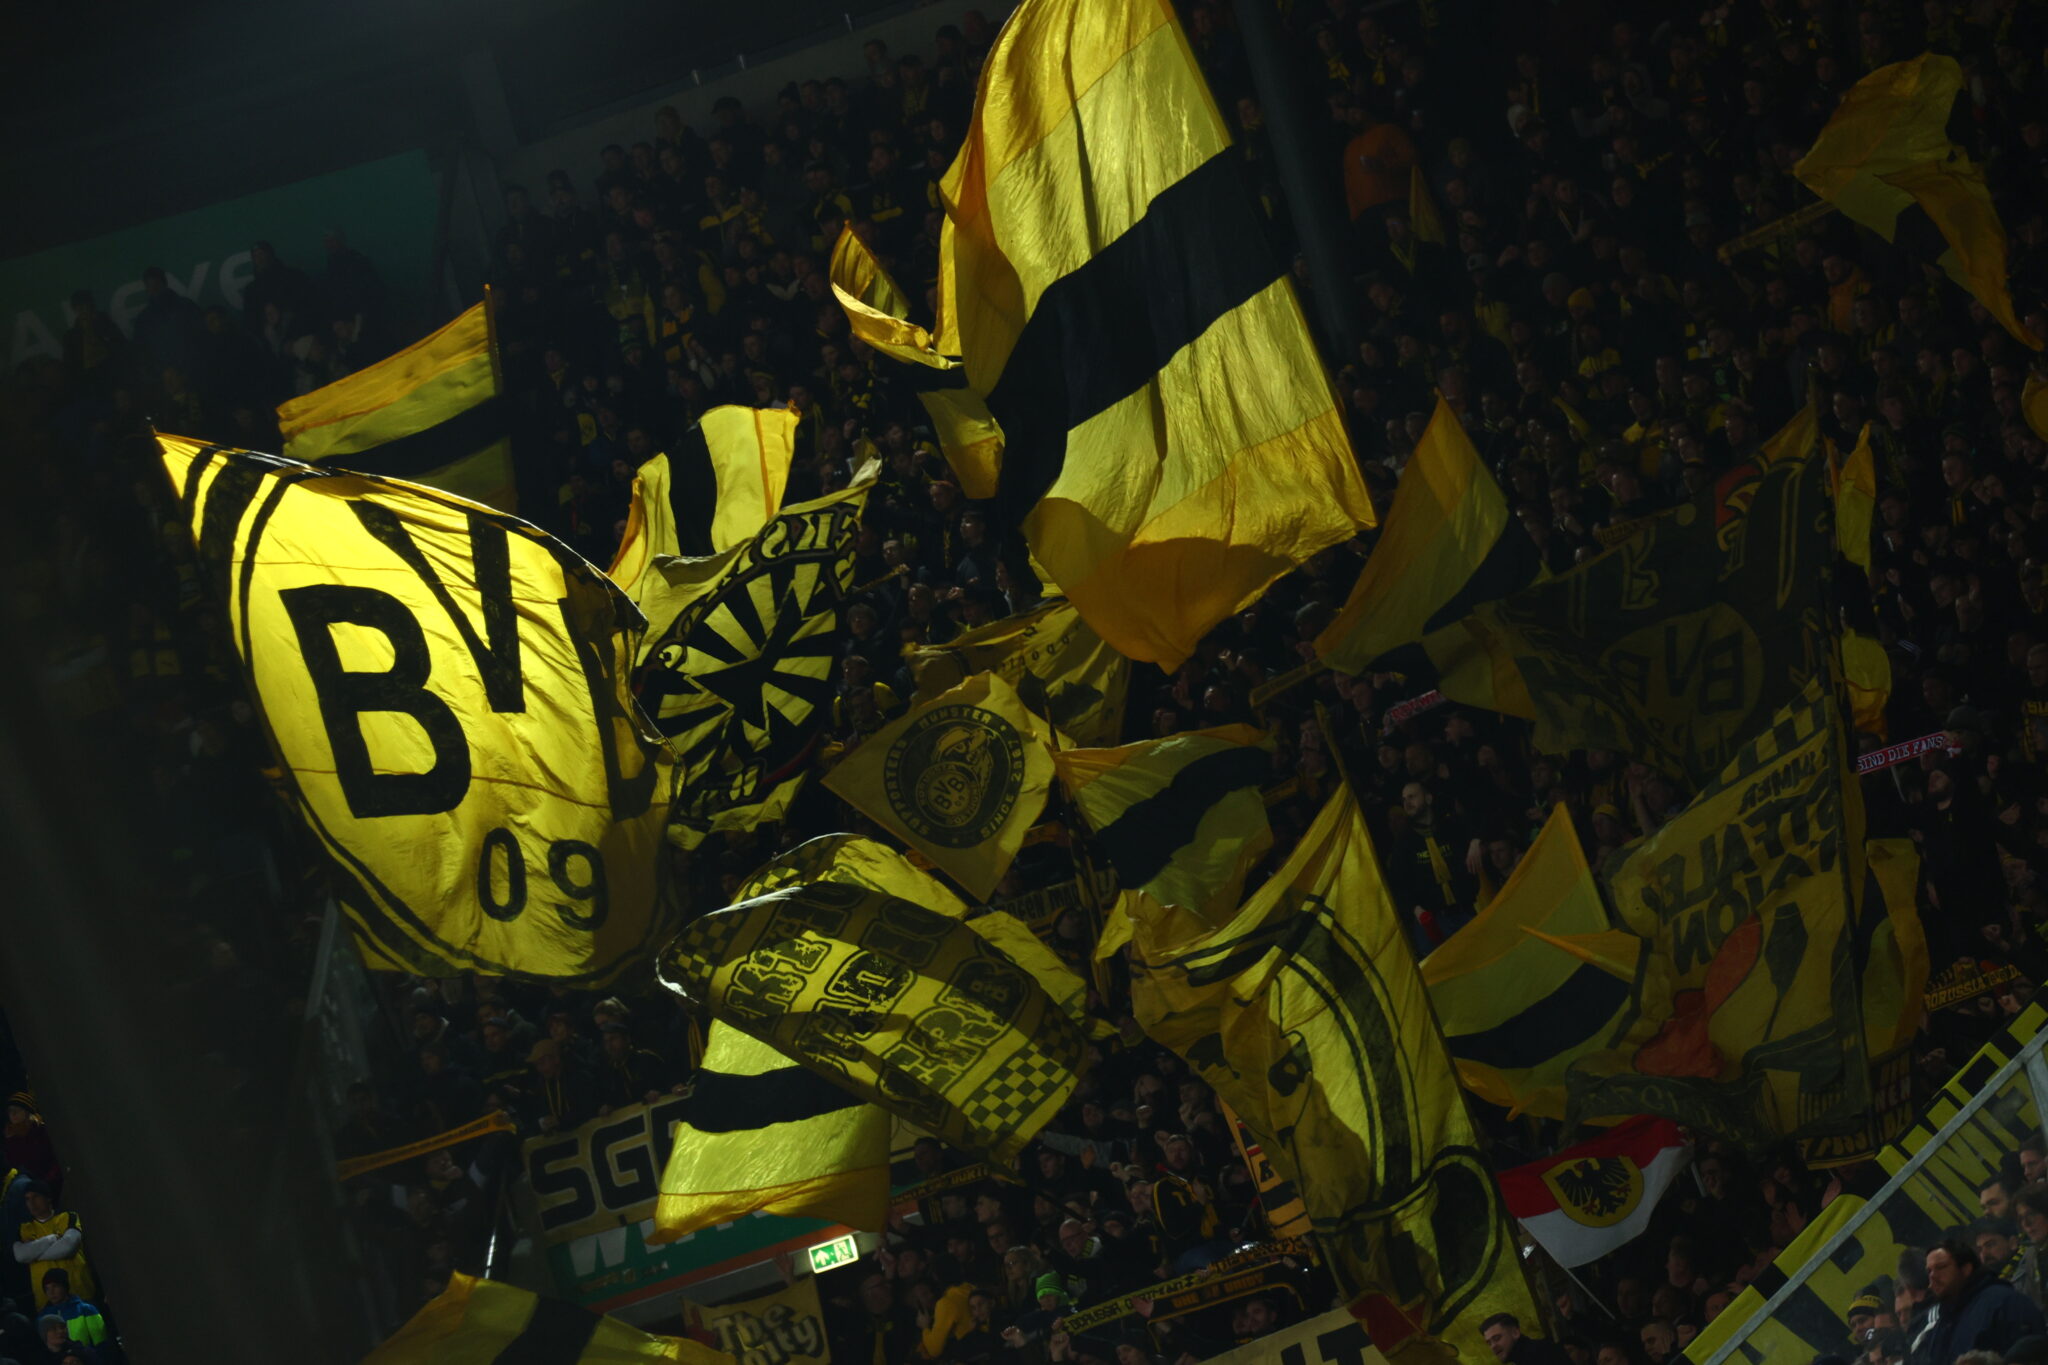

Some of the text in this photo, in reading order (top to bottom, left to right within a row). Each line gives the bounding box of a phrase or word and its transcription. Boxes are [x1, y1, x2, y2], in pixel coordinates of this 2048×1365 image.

[478, 826, 609, 931] 09
[711, 1303, 796, 1355] The
[741, 1315, 825, 1365] nity
